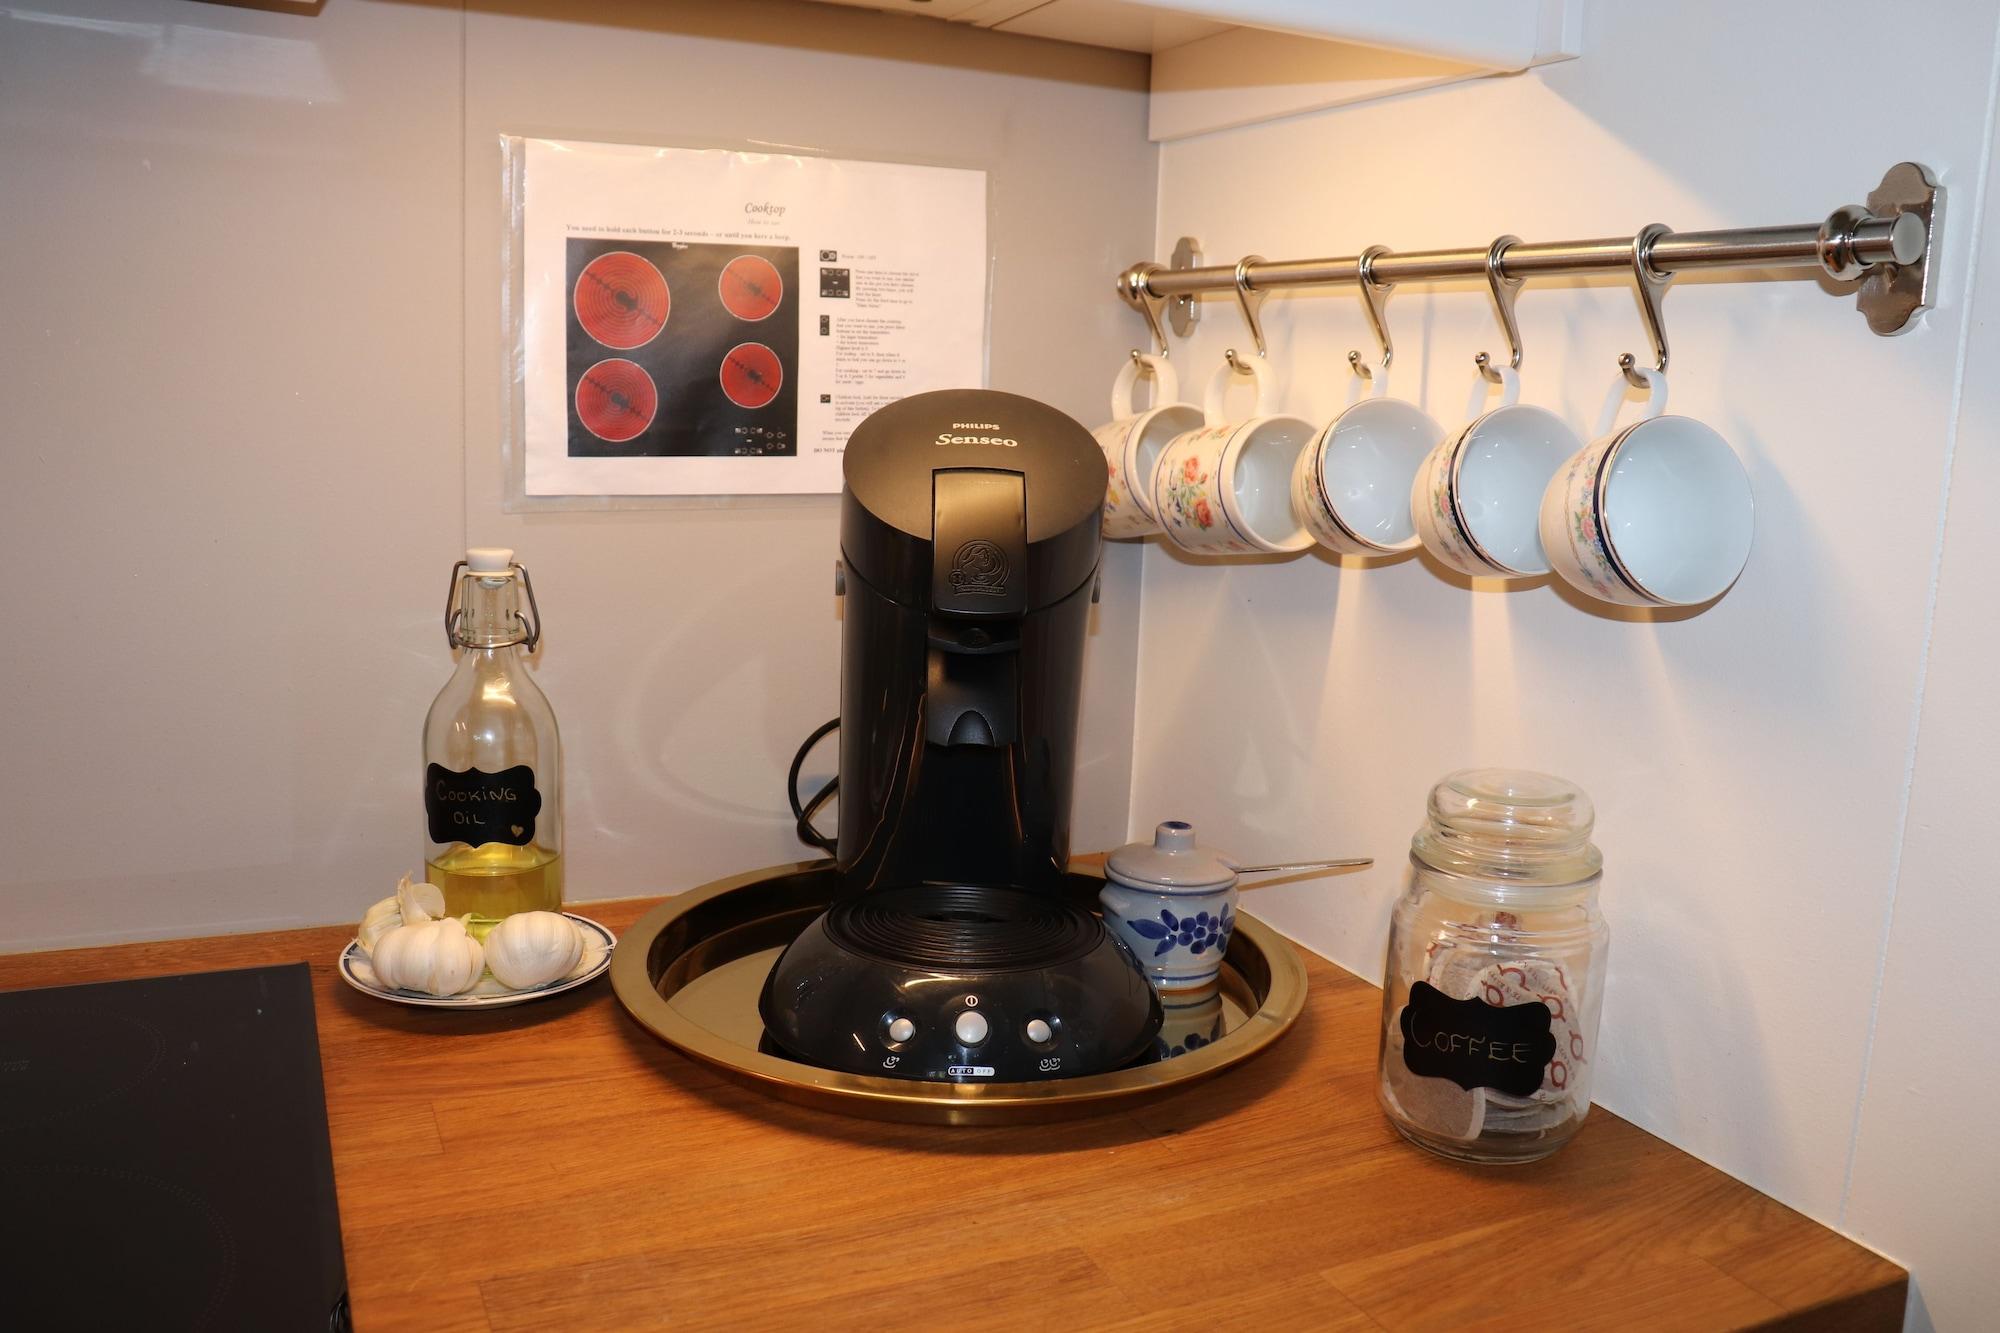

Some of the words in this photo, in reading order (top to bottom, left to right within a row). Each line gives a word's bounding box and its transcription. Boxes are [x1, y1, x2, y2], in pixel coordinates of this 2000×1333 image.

[744, 202, 786, 216] Cooktop
[606, 225, 621, 233] hold
[638, 227, 660, 235] button
[724, 231, 740, 239] until
[952, 422, 1001, 431] PHILIPS
[935, 433, 1018, 447] Senseo
[1410, 1011, 1532, 1064] COFFEE
